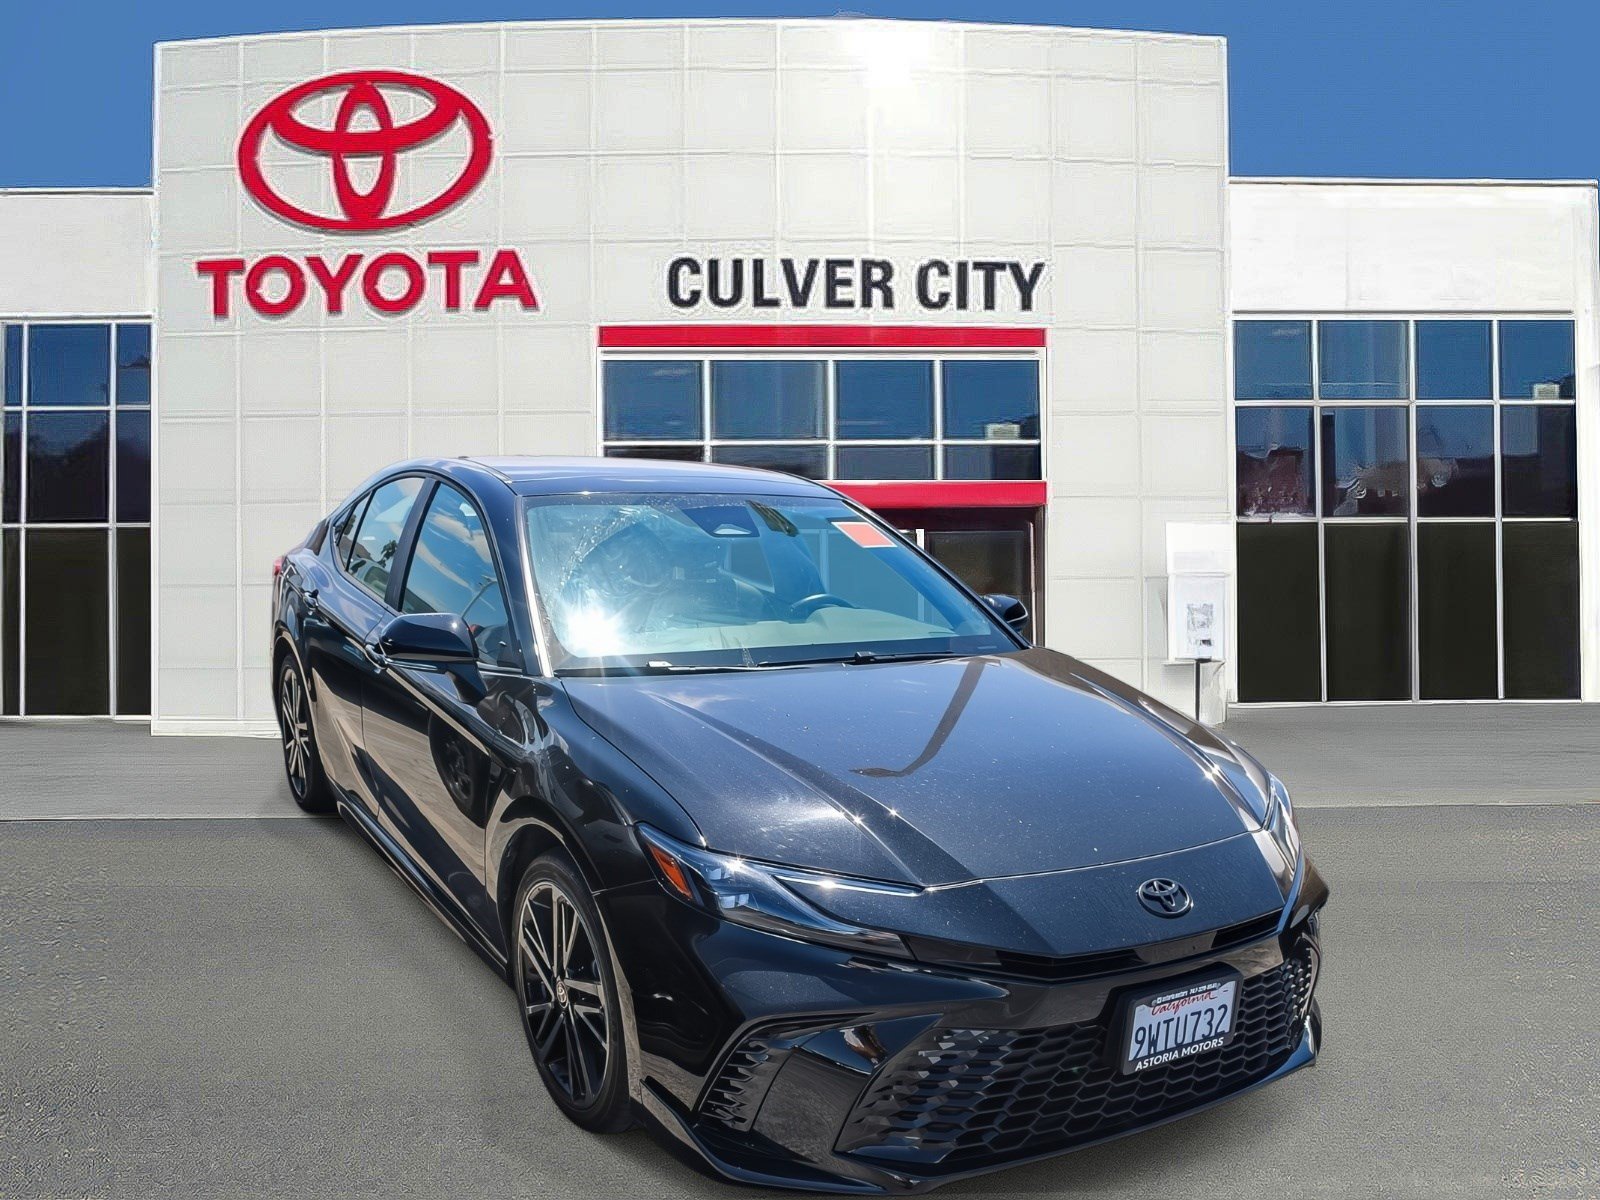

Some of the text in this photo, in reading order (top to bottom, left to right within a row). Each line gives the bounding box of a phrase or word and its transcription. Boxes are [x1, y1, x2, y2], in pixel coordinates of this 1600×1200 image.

[196, 249, 537, 317] TOYOTA
[667, 257, 1045, 311] CULVER CITY
[1151, 991, 1218, 1015] California
[1134, 1003, 1229, 1059] 9WTU732
[1135, 1037, 1224, 1071] ASTORIA MOTORS
